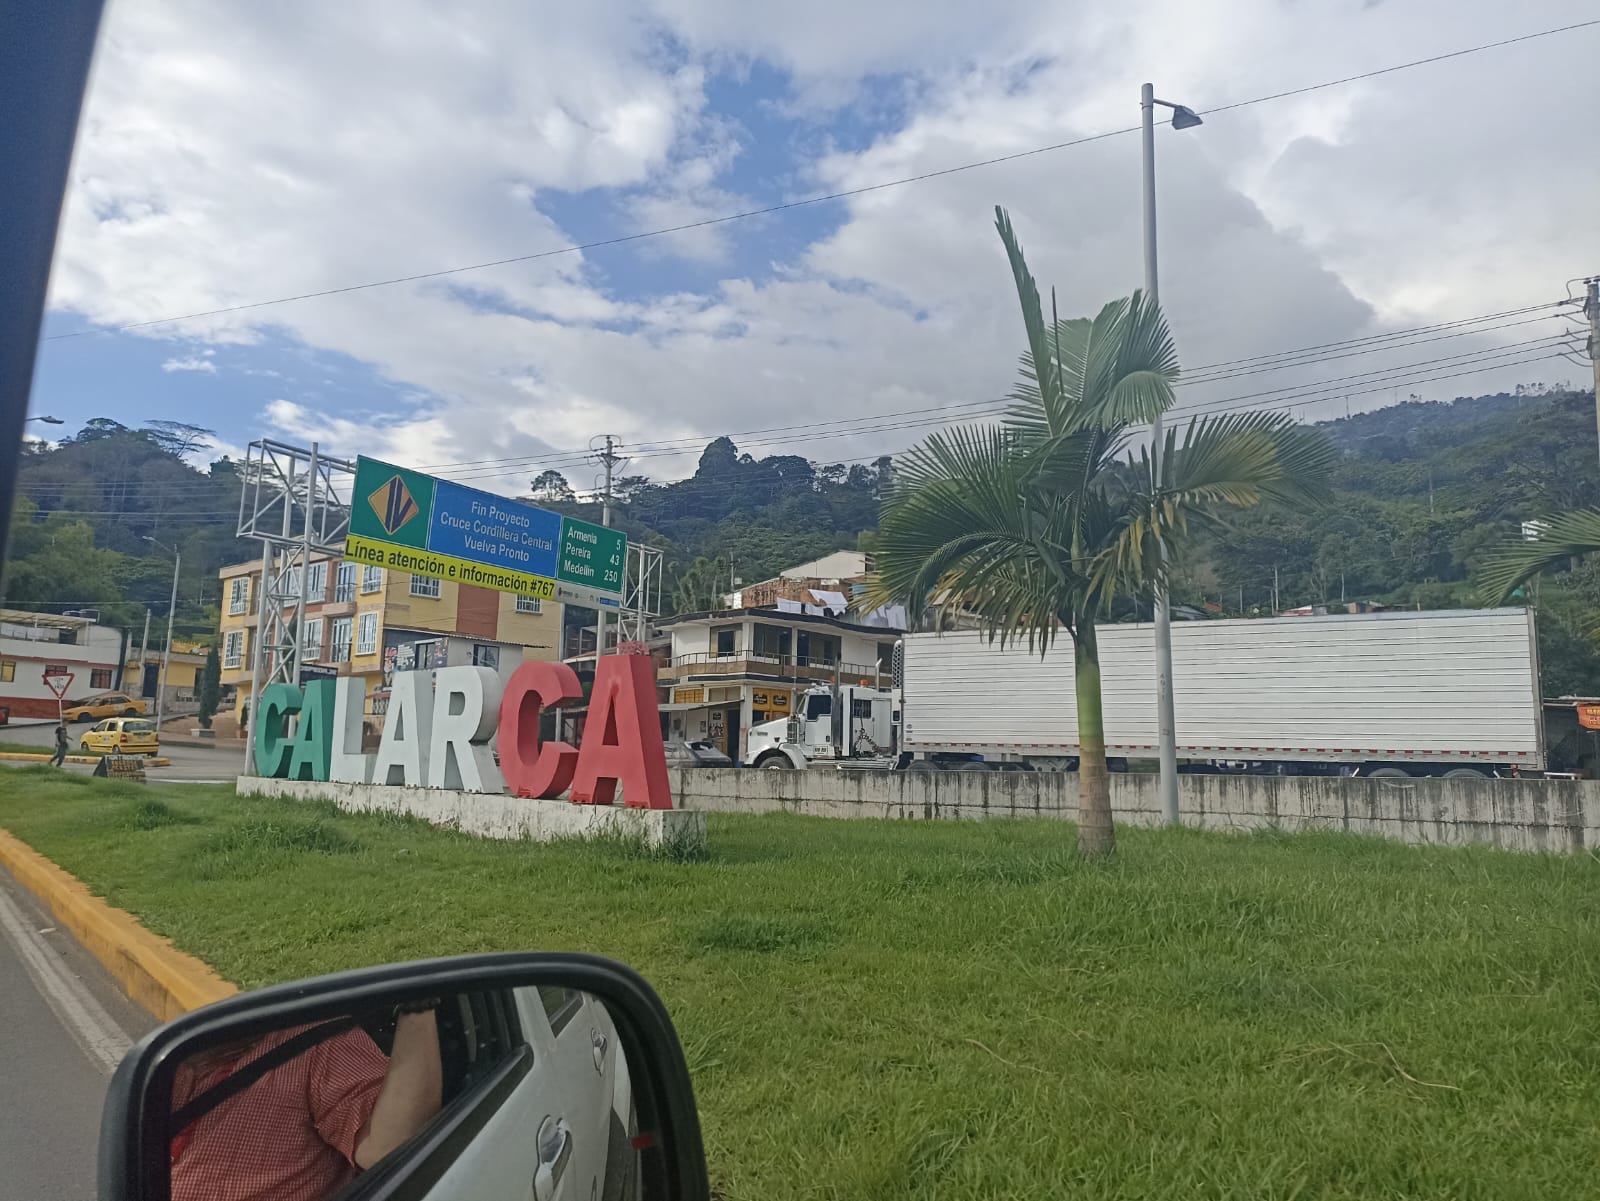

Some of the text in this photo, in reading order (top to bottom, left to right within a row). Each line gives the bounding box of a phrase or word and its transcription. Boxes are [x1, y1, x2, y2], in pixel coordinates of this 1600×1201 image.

[471, 501, 530, 528] Fin Proyecto
[440, 511, 553, 552] Cruce Cordillera Central
[567, 526, 622, 551] Armenia 5
[464, 535, 530, 562] Vuelva Pronto
[565, 541, 621, 566] Pereira 43
[344, 539, 555, 597] Línea atención e información #767
[603, 569, 618, 583] 250
